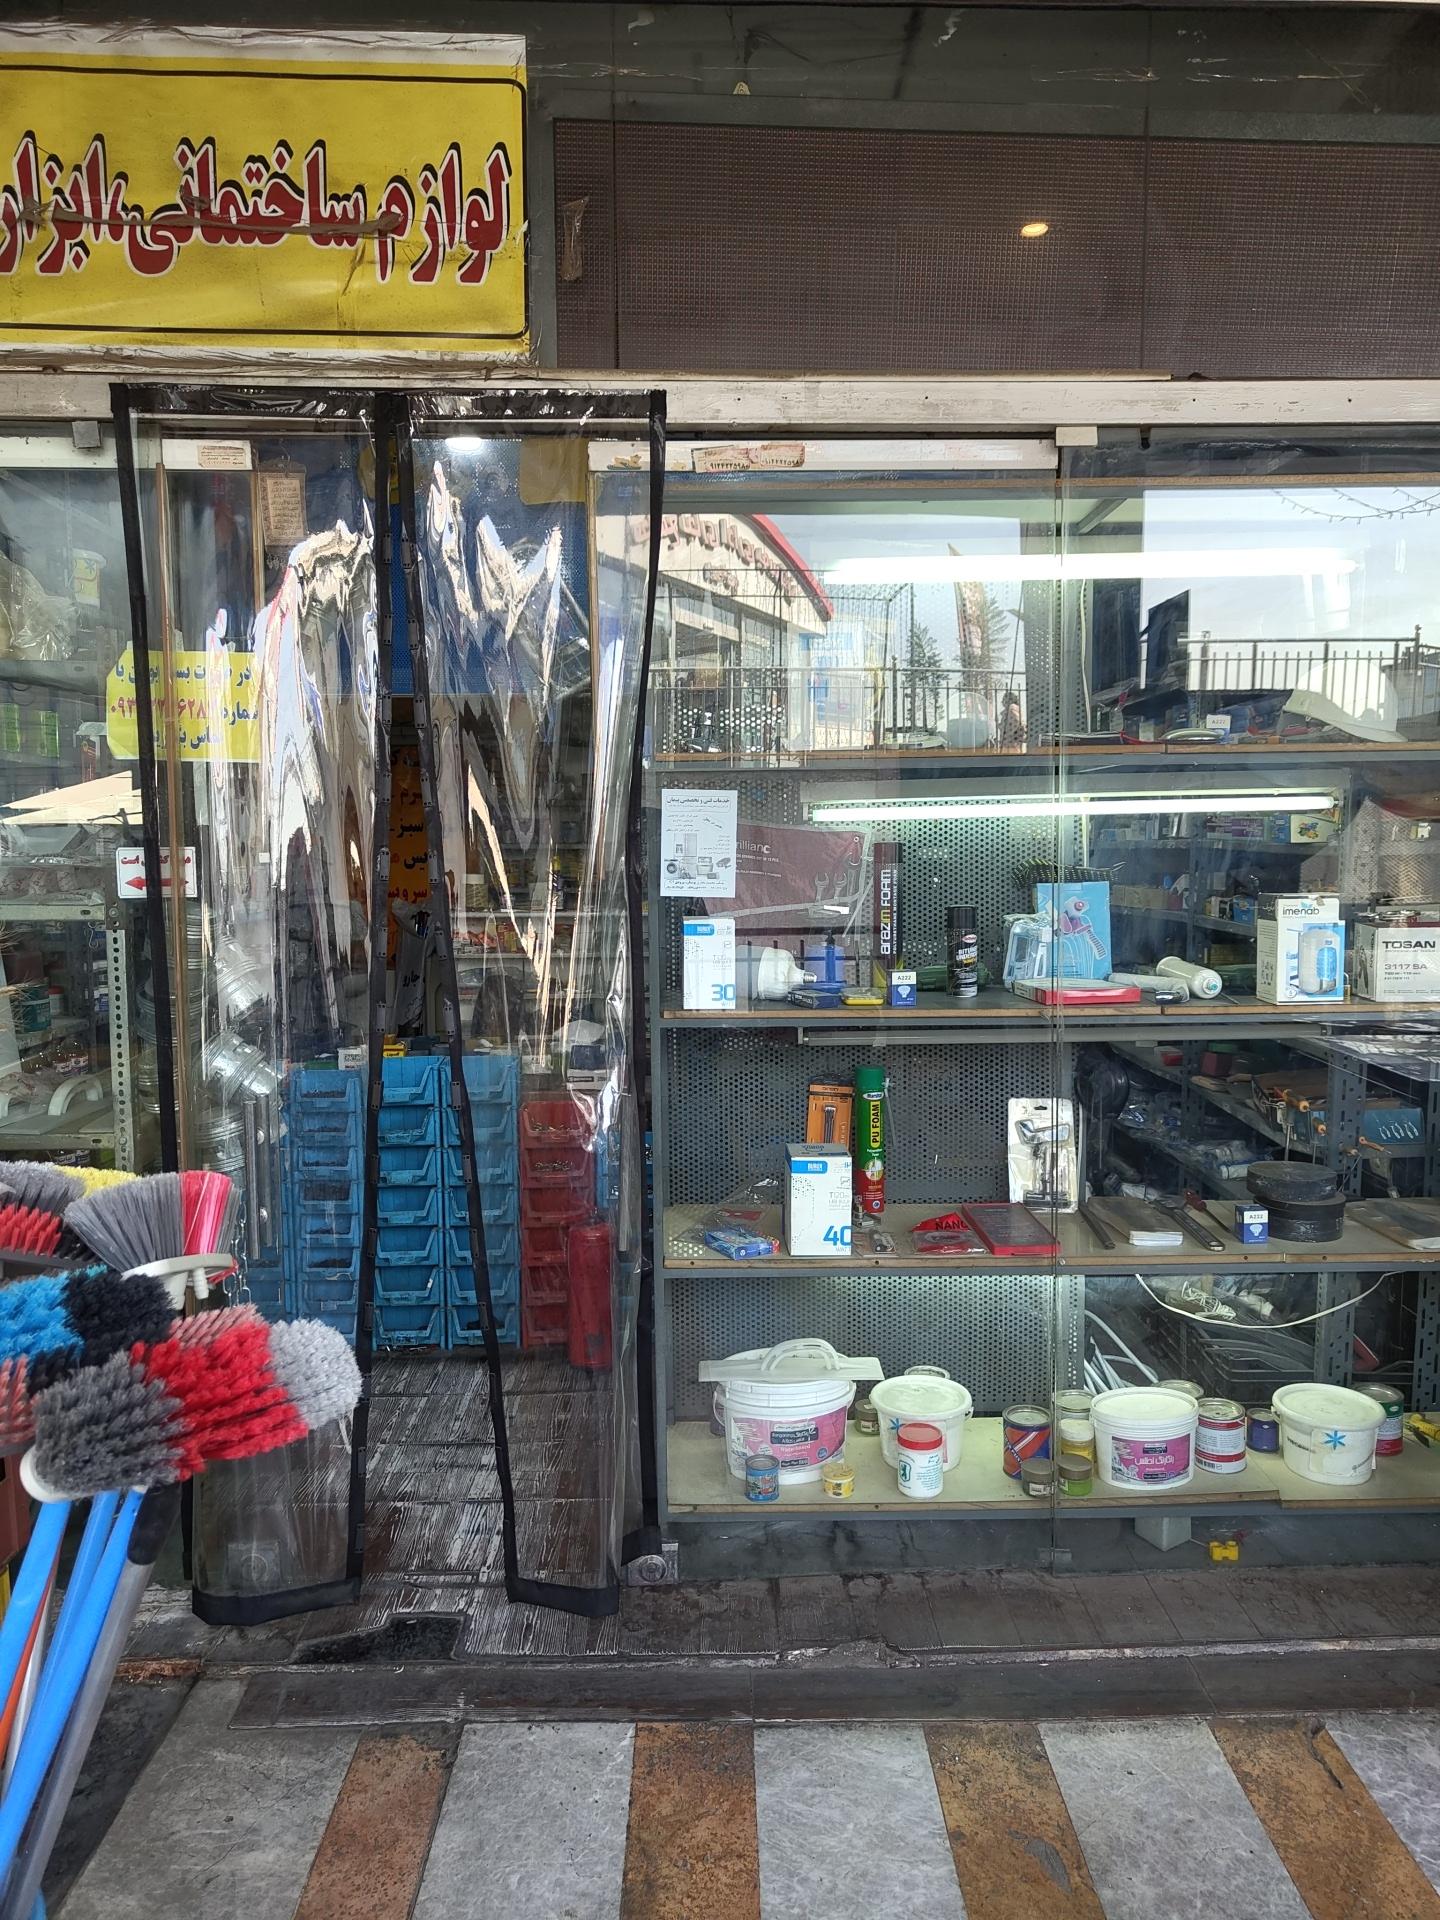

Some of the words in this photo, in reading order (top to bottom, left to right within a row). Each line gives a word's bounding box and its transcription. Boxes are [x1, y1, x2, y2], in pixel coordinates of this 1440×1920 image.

[377, 141, 511, 285] لوازم
[880, 869, 891, 907] FOAM
[1282, 907, 1320, 915] imenab
[880, 909, 891, 955] arazim
[1382, 940, 1436, 949] TOSAN
[711, 984, 736, 1001] 30
[871, 1103, 880, 1129] FOAM
[871, 1131, 880, 1144] PU
[823, 1225, 852, 1246] 40
